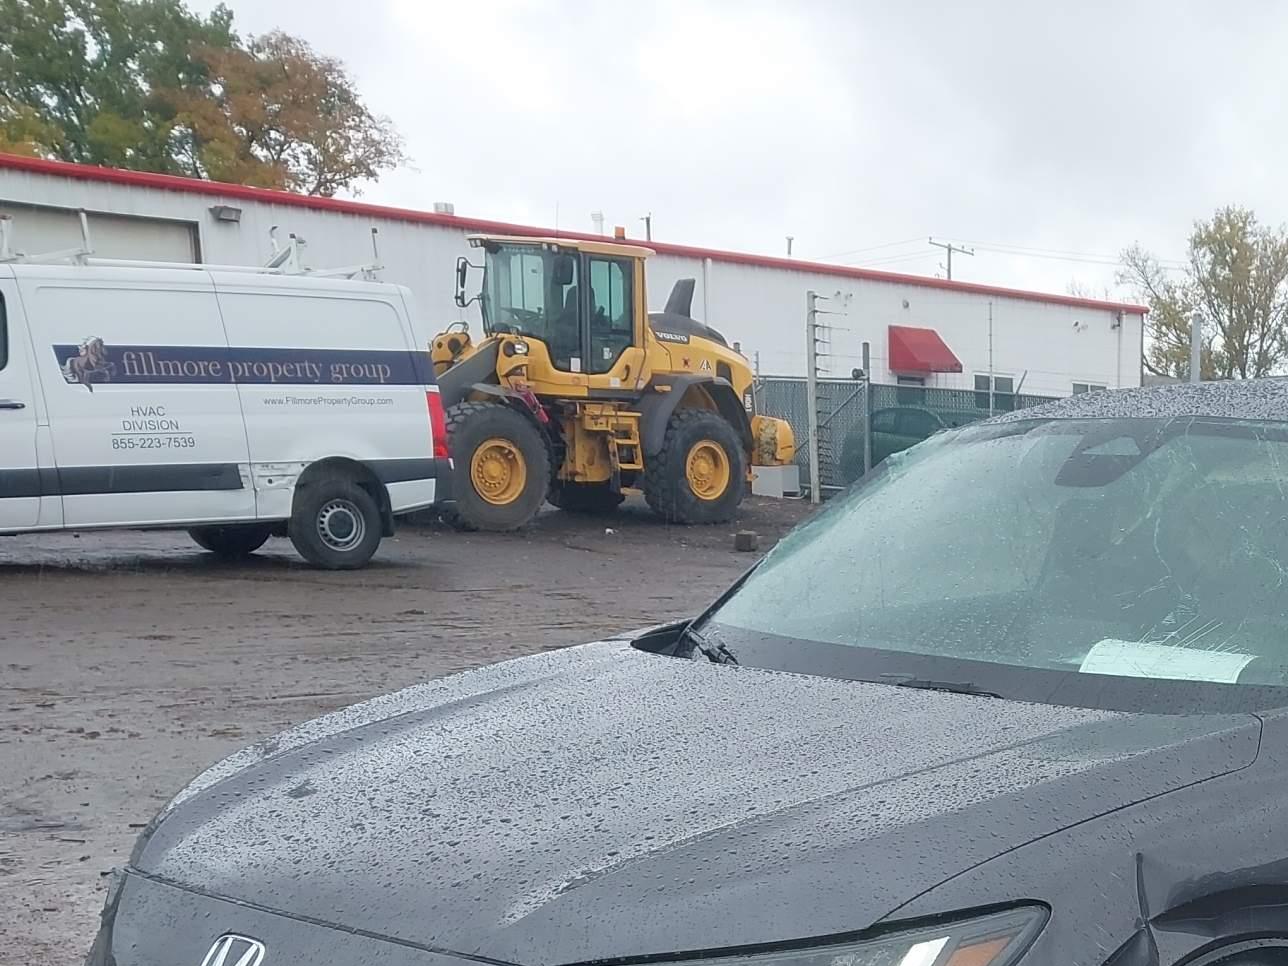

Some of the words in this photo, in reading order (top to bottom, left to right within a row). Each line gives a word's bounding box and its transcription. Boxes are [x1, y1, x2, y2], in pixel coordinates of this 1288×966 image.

[655, 331, 688, 342] VOLVO
[122, 351, 221, 377] fillmore
[227, 360, 322, 382] property
[330, 362, 391, 383] group
[263, 396, 394, 406] www.FillmorePropertyGroup.com
[131, 406, 166, 417] HVAC
[122, 419, 179, 431] DIVISION
[111, 436, 196, 450] 855-223-7539
